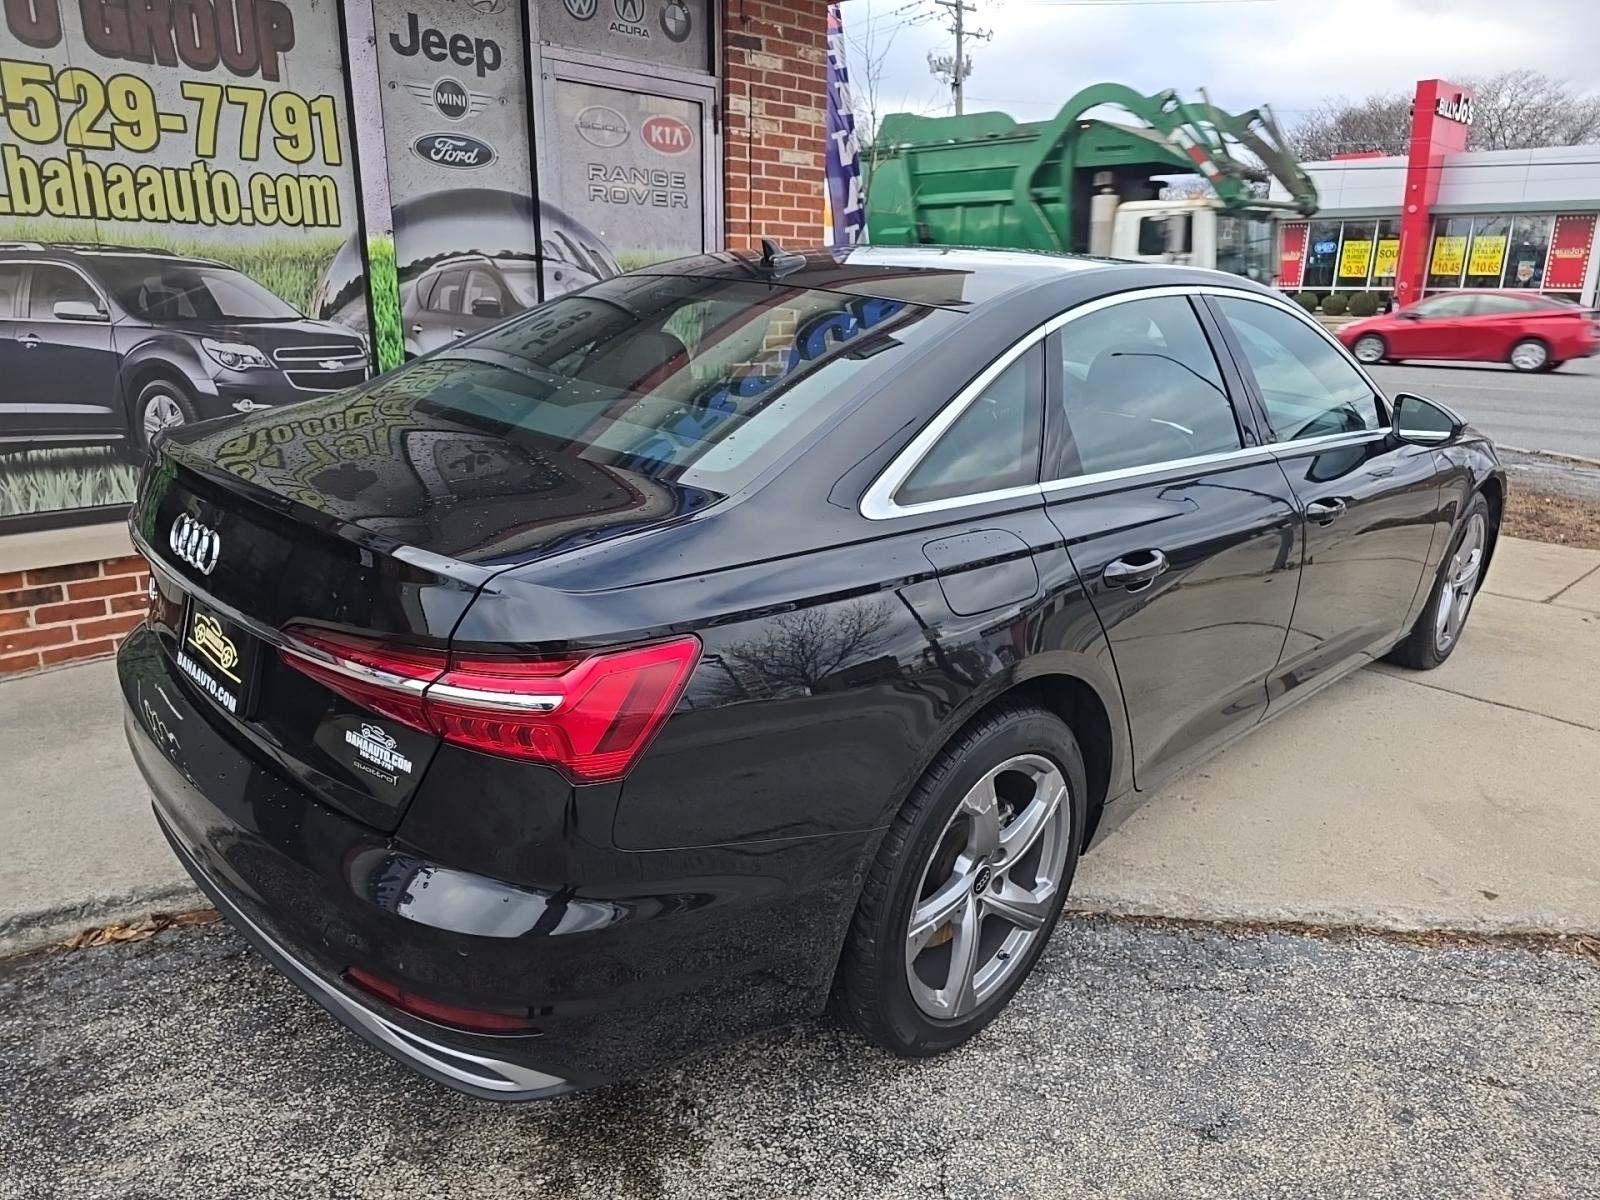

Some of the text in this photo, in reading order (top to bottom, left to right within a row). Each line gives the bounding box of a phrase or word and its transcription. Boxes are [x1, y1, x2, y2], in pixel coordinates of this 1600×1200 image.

[80, 0, 295, 82] GROUP
[609, 22, 650, 38] ACURA
[389, 13, 502, 77] Jeep
[0, 58, 342, 166] 529-7791
[437, 93, 467, 108] MINI
[650, 125, 685, 146] KIA
[430, 138, 480, 165] Ford
[588, 163, 686, 188] RANGE
[588, 184, 688, 208] ROVER
[1379, 249, 1400, 258] SOU
[176, 651, 237, 713] BAHAAUTO.COM
[345, 730, 412, 774] BAHAAUTO.COM
[353, 761, 393, 783] quattro
